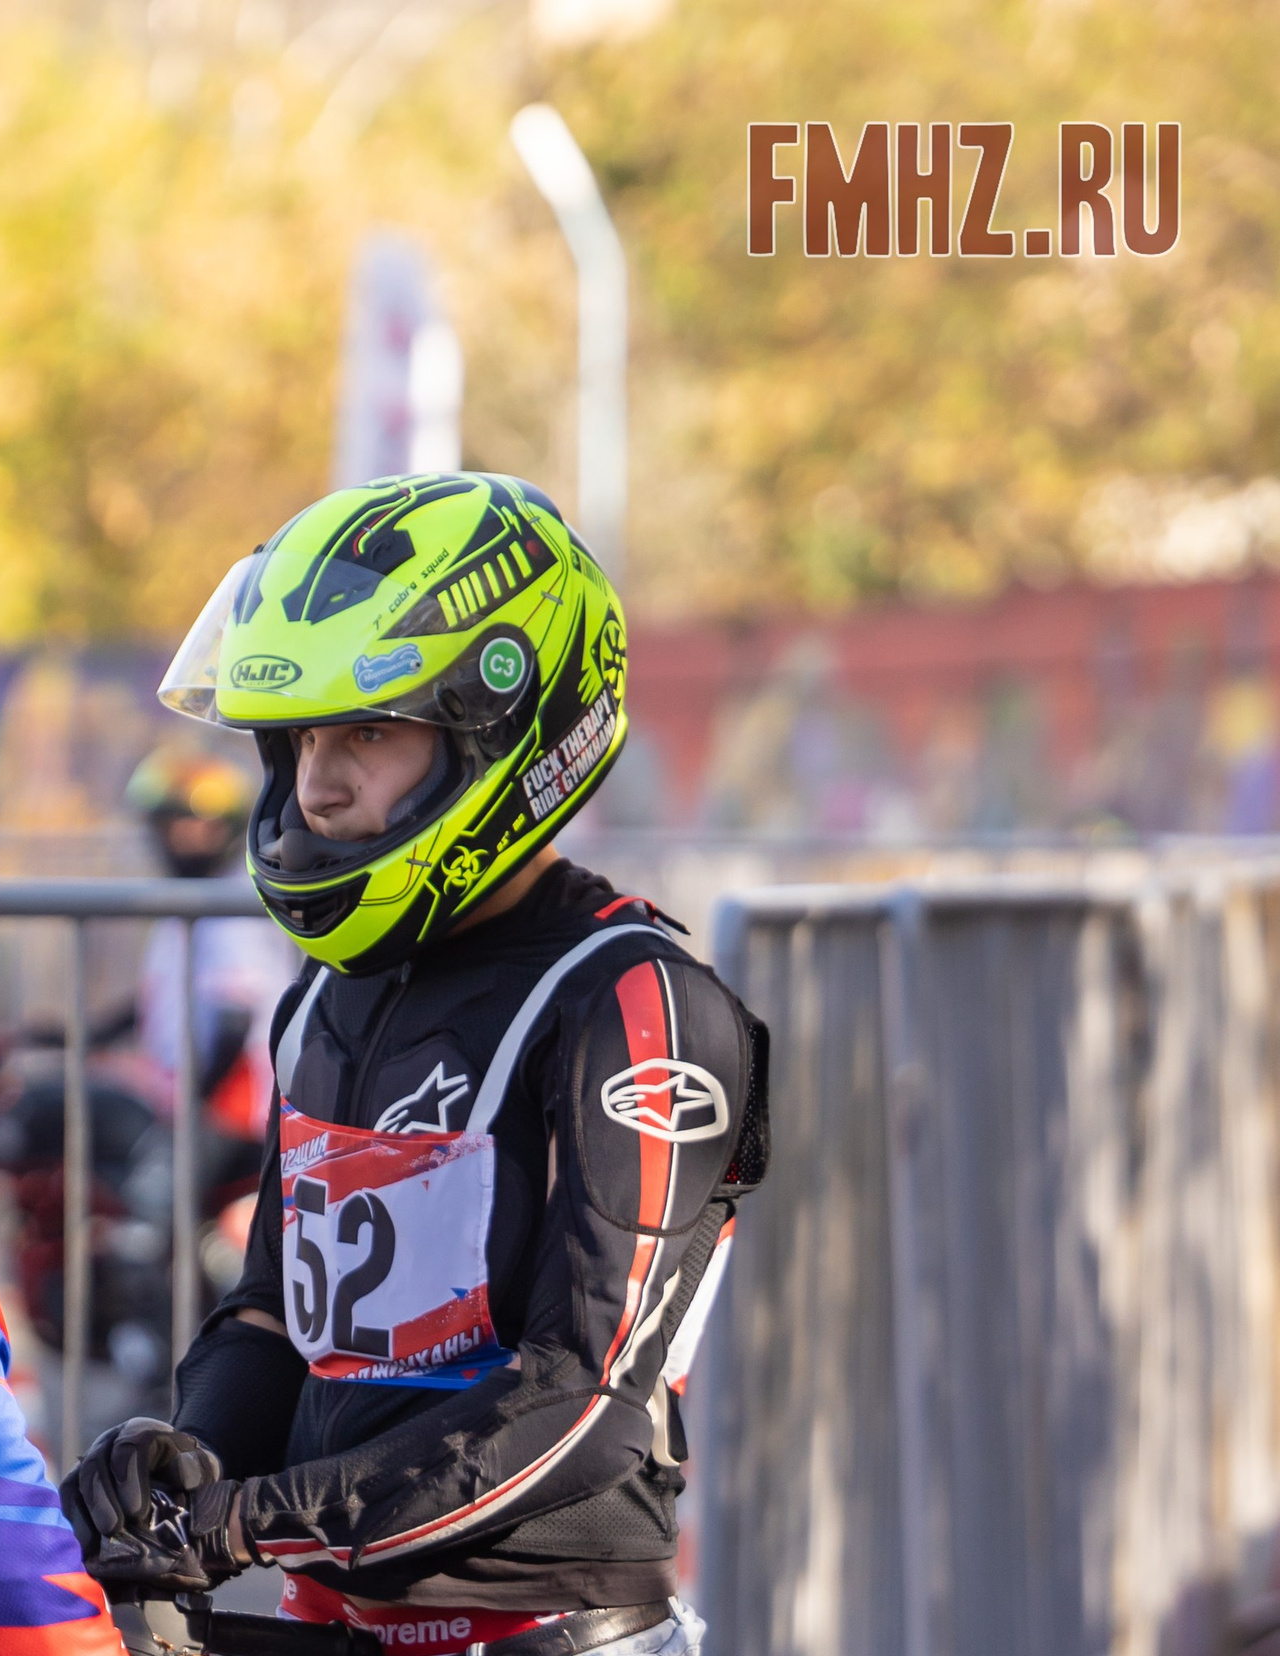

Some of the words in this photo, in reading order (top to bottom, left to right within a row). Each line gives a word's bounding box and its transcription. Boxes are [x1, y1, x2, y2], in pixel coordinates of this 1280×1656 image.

[388, 581, 418, 613] cobra
[420, 547, 450, 578] squad
[236, 662, 291, 682] HJC
[489, 655, 514, 677] C3
[522, 748, 563, 799] FUCK
[558, 688, 612, 765] THERAPY
[529, 778, 564, 821] RIDE
[291, 1176, 397, 1359] 52
